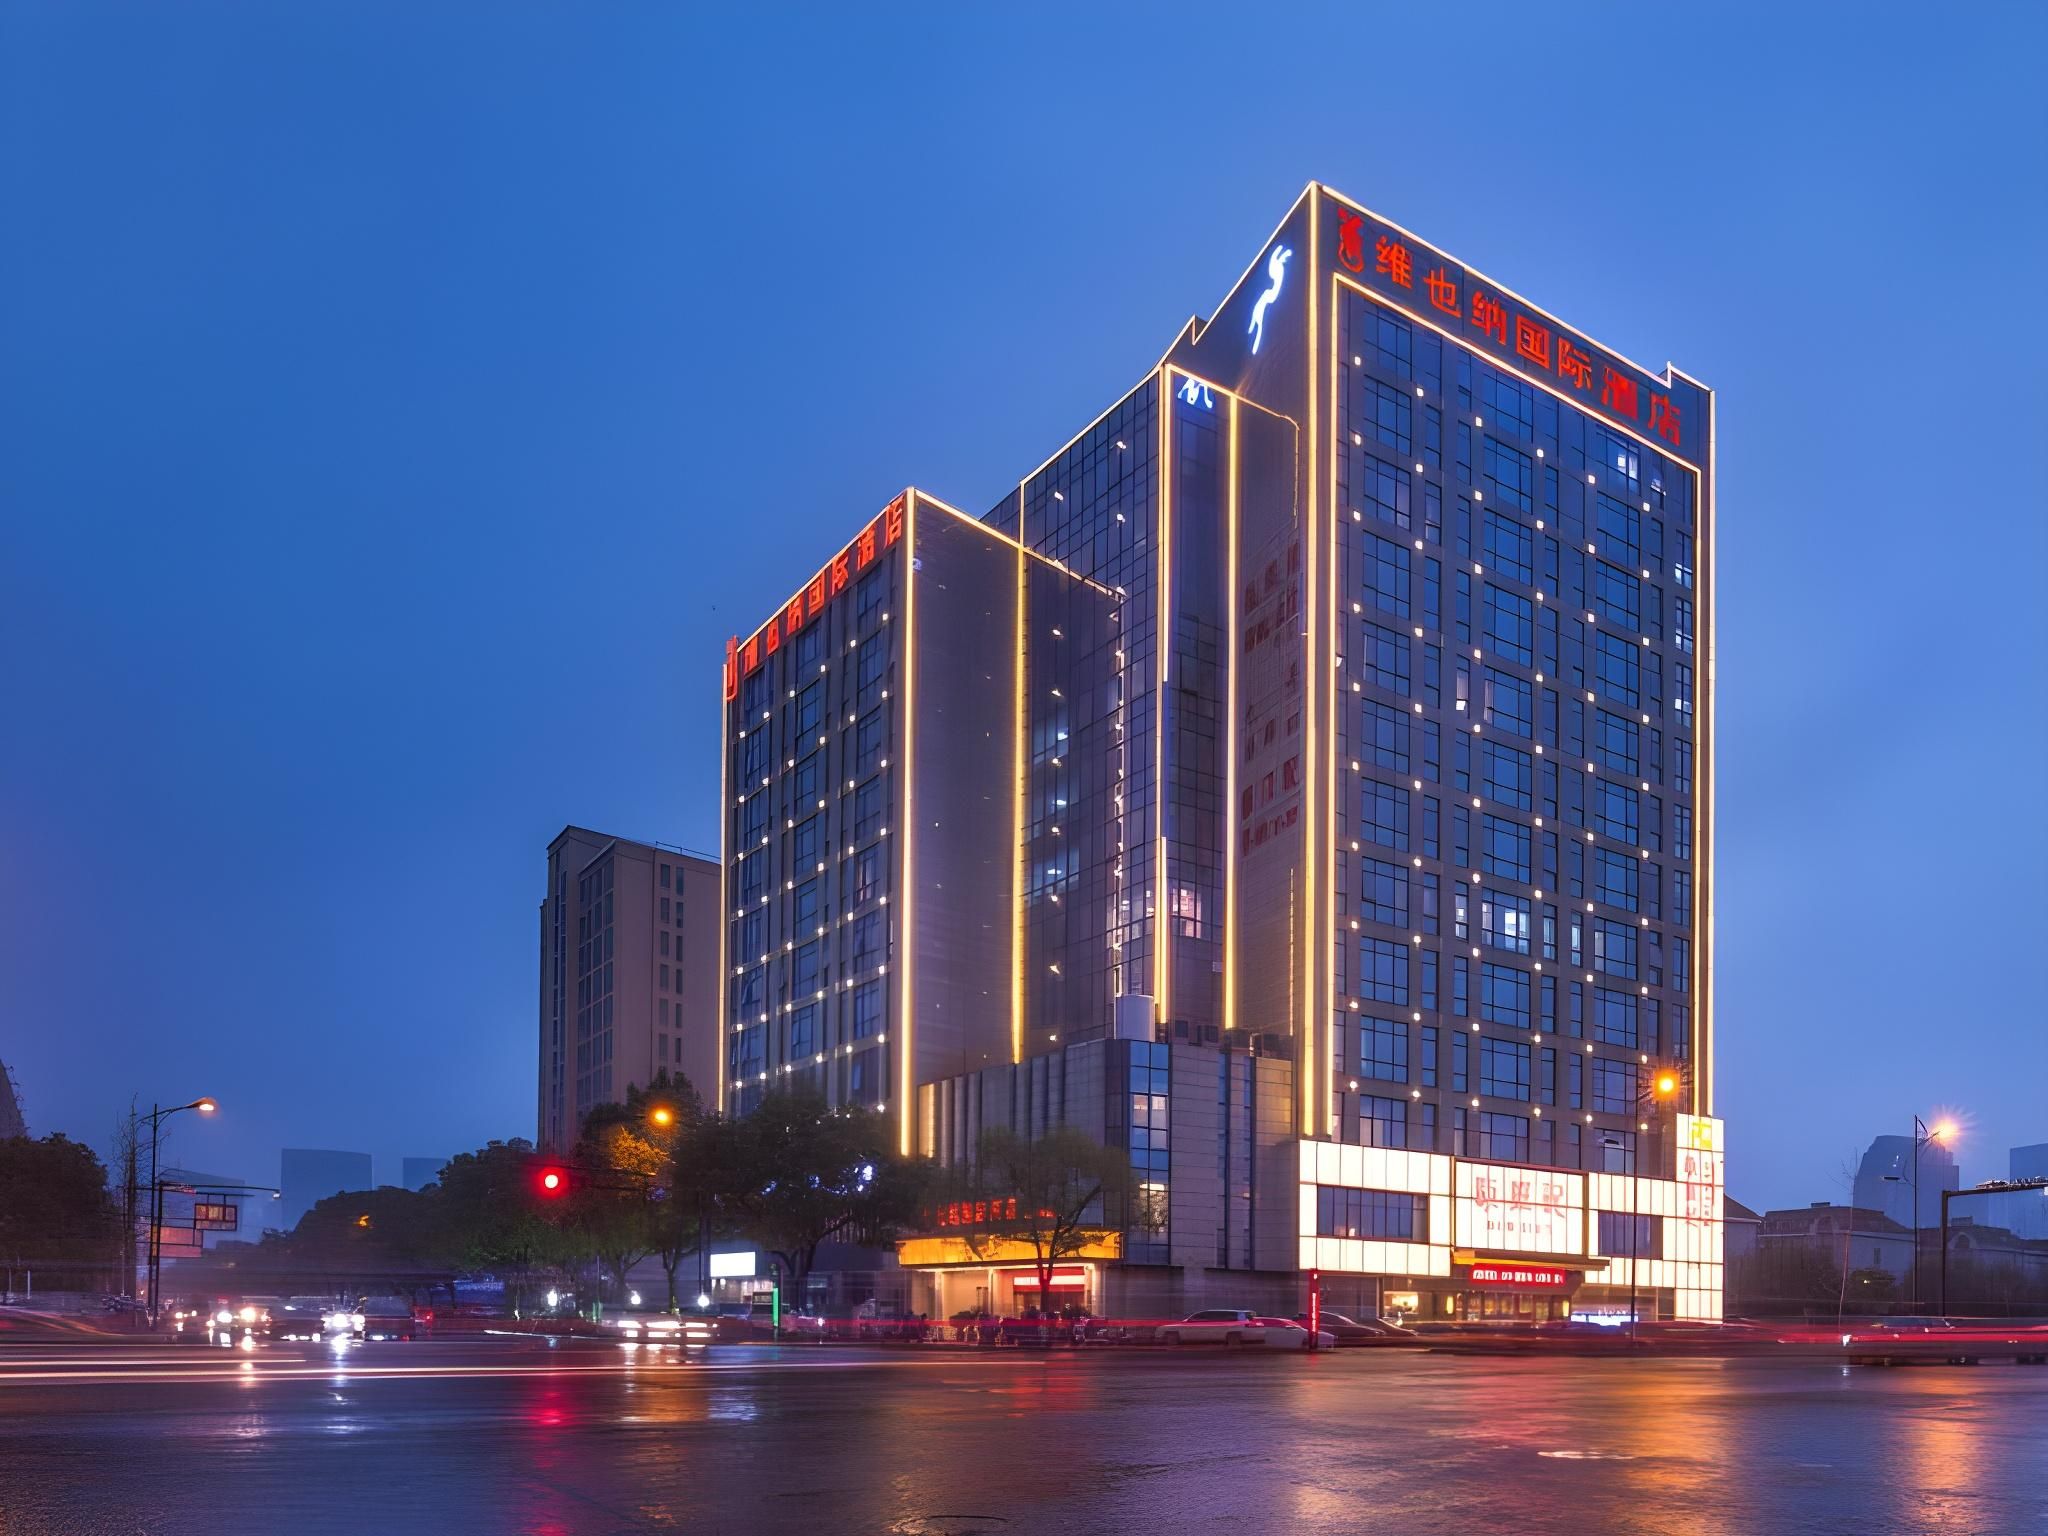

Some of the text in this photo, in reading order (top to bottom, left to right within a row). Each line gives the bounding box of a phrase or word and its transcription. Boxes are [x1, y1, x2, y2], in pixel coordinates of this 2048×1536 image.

[1375, 235, 1681, 447] 维也纳国际酒店
